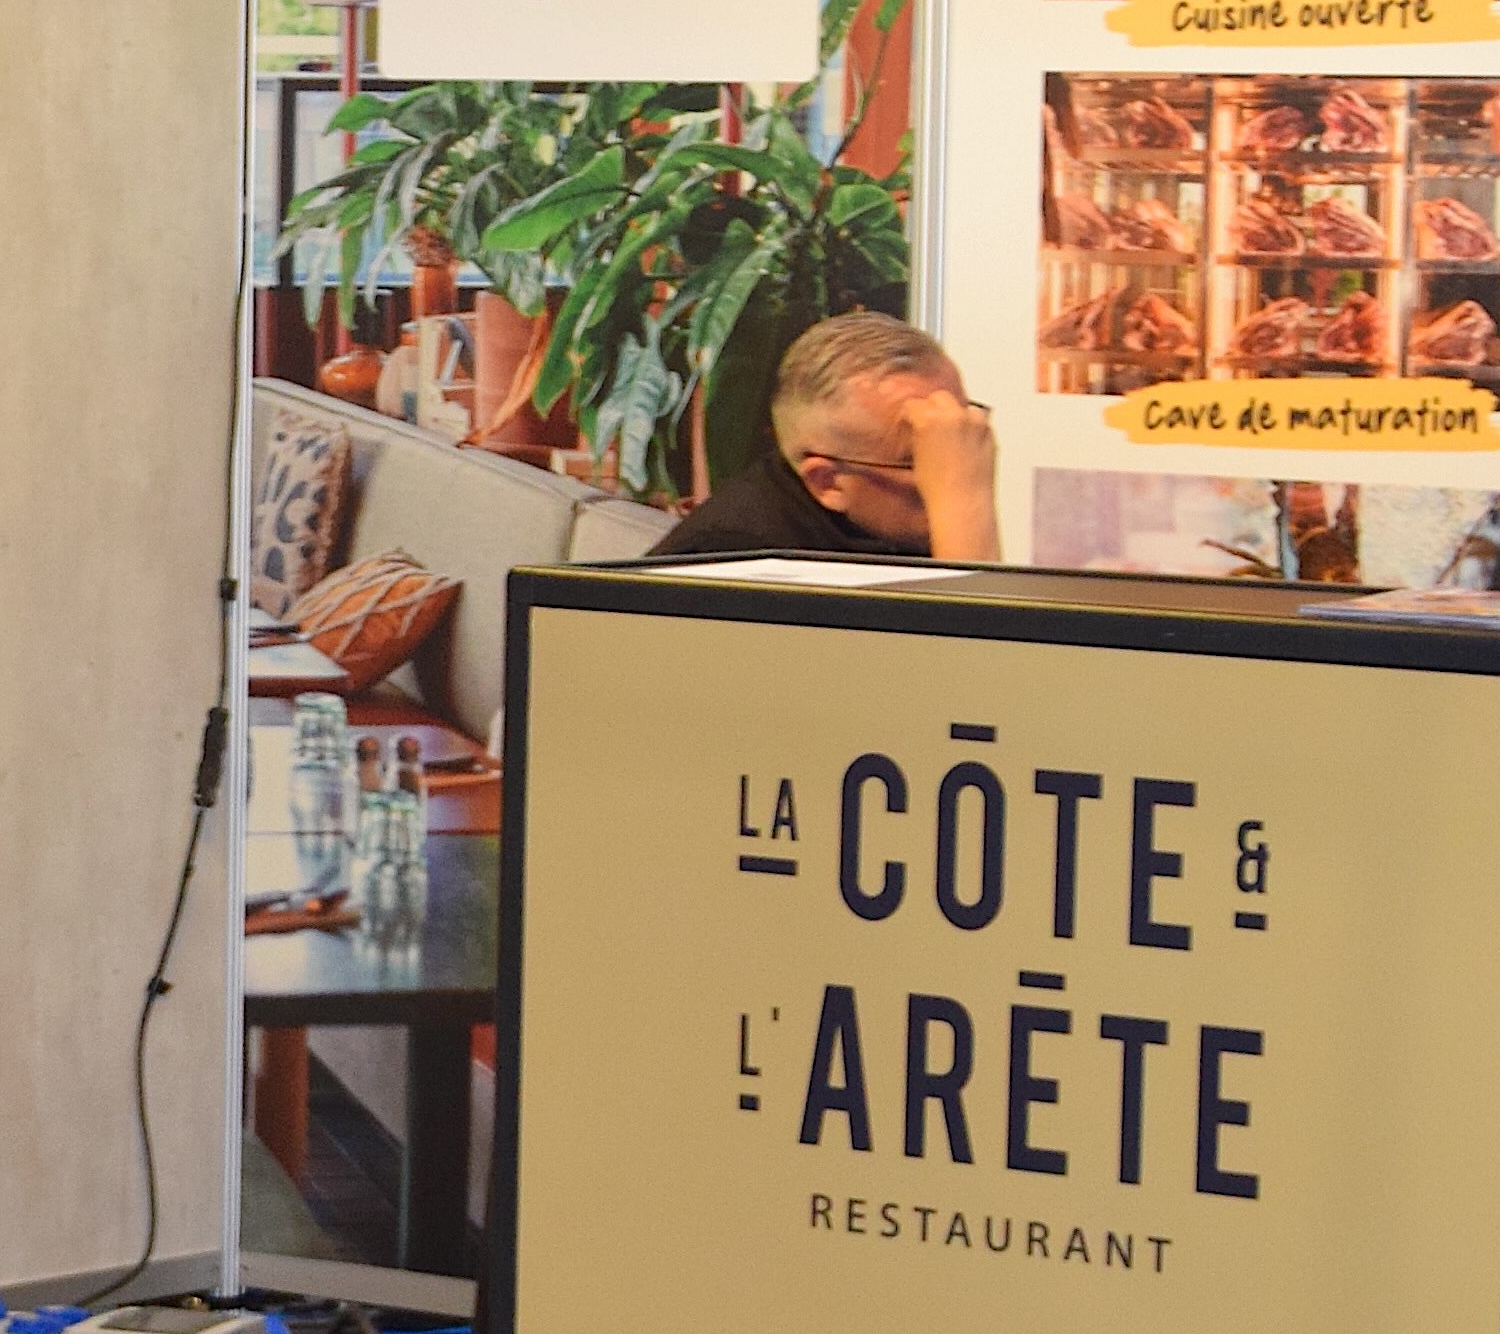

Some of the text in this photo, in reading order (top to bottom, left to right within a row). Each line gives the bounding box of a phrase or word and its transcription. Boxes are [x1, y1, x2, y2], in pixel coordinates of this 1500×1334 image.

[1143, 397, 1479, 437] Cave de maturation
[740, 774, 799, 841] LA
[1236, 820, 1270, 894] &
[810, 1193, 1173, 1274] RESTAURANT
